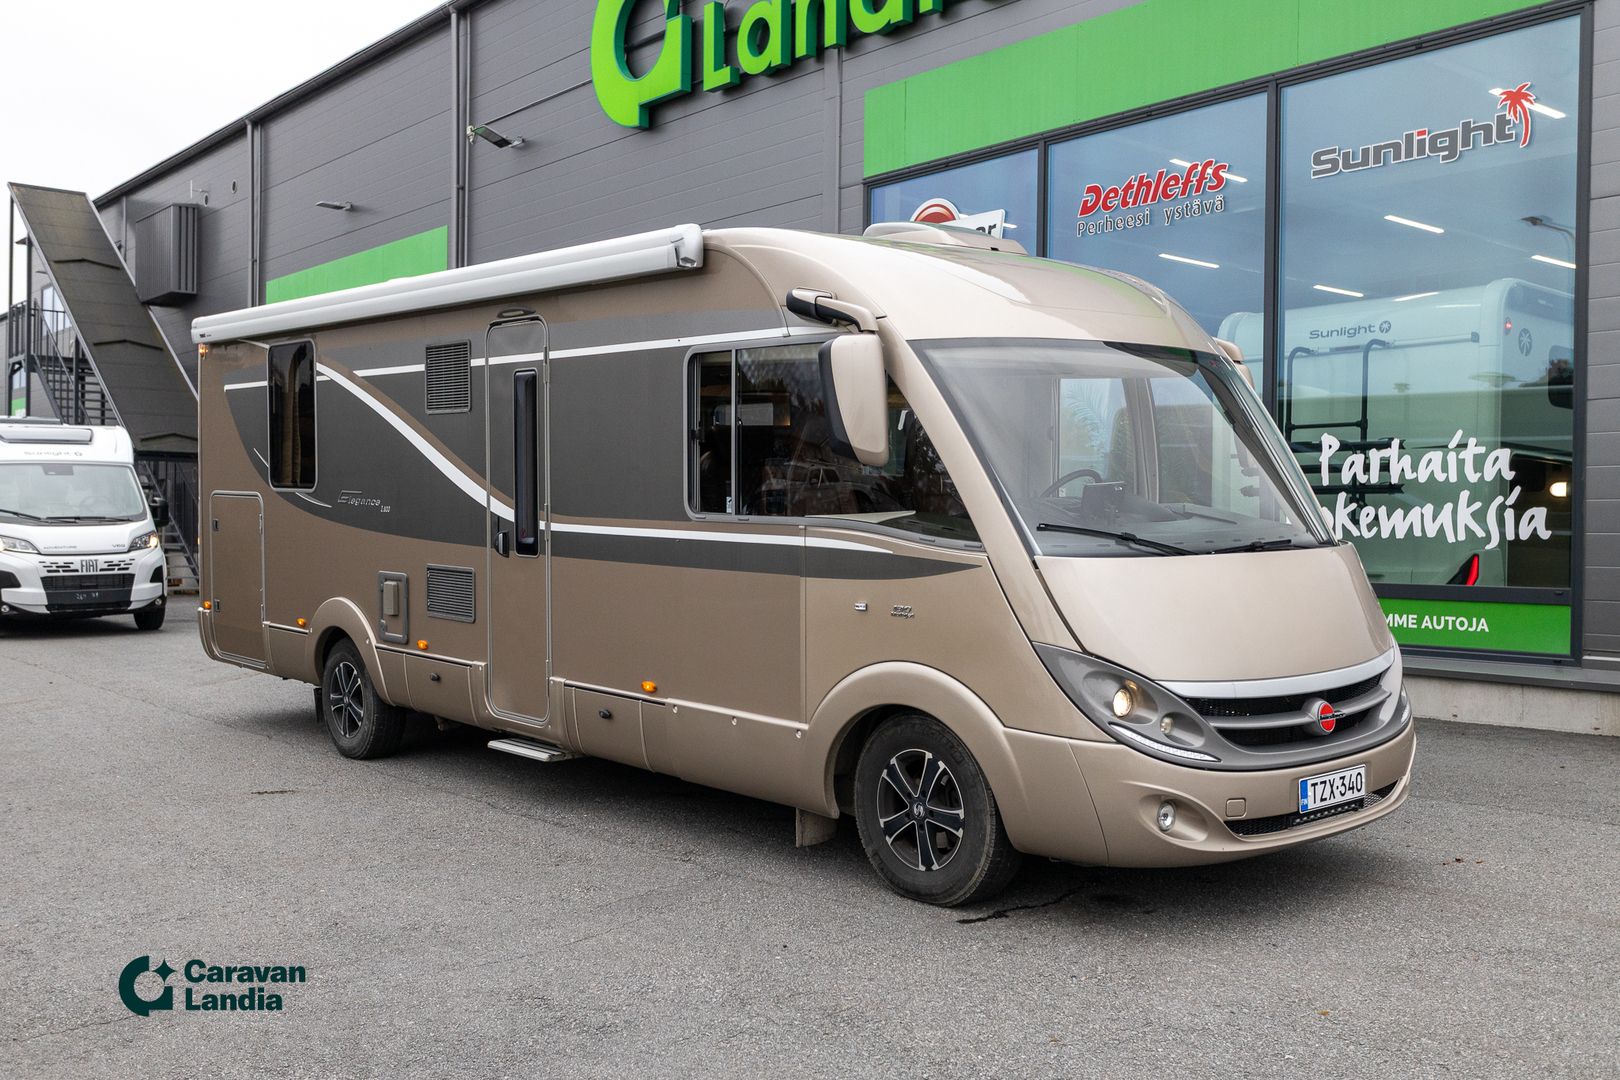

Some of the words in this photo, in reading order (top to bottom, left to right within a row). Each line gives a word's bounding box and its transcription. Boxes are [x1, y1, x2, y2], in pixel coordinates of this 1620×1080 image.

[1311, 112, 1516, 180] Sunlight
[1078, 158, 1228, 218] Dethleffs
[1077, 208, 1151, 237] Perheesi
[1163, 194, 1226, 227] ystävä
[1309, 323, 1377, 340] Sunlight
[1319, 429, 1516, 487] Parhaita
[337, 489, 381, 506] Elegance
[80, 559, 99, 573] FIAT
[1421, 615, 1490, 633] AUTOJA
[1311, 772, 1363, 804] TZX-340
